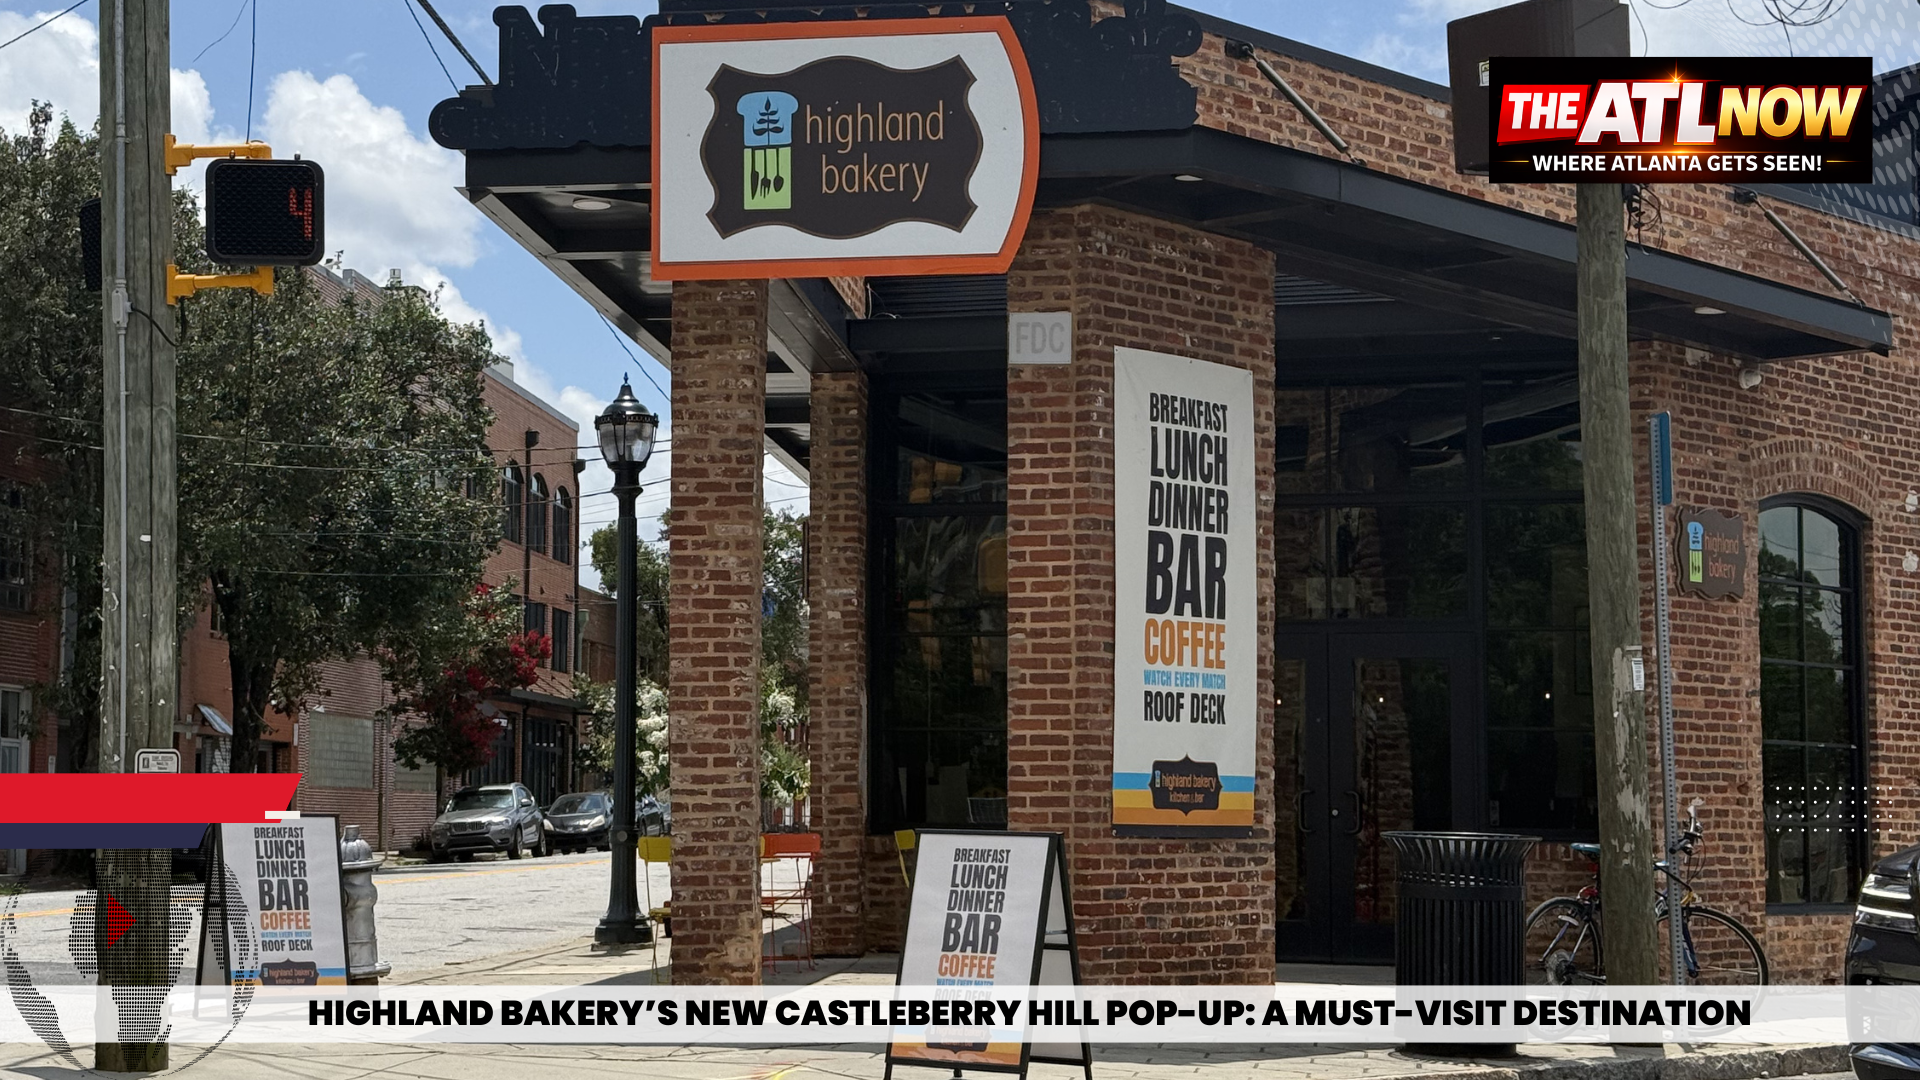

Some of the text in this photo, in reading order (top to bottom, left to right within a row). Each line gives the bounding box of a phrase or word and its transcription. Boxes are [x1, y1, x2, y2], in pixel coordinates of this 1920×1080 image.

[806, 100, 944, 154] highland
[822, 152, 929, 203] bakery
[288, 187, 313, 241] 4
[1015, 322, 1065, 354] FDC
[1150, 392, 1228, 433] BREAKFAST
[1150, 426, 1228, 487] LUNCH
[1148, 480, 1229, 535] DINNER
[1704, 531, 1739, 557] highland
[1145, 530, 1228, 620] BAR
[1708, 556, 1736, 584] bakery
[1144, 618, 1226, 669] COFFEE
[1144, 669, 1226, 690] WATCH EVERY MATCH
[1144, 690, 1226, 725] ROOF DECK
[1161, 773, 1217, 792] highland bakery
[254, 827, 305, 839] BREAKFAST
[255, 840, 306, 859] LUNCH
[953, 848, 1012, 864] BREAKFAST
[256, 860, 308, 878] DINNER
[950, 864, 1009, 889] LUNCH
[258, 878, 310, 911] BAR
[946, 889, 1006, 914] DINNER
[259, 911, 311, 931] COFFEE
[941, 912, 1002, 955] BAR
[261, 939, 314, 952] ROOF DECK
[937, 954, 997, 979] COFFEE
